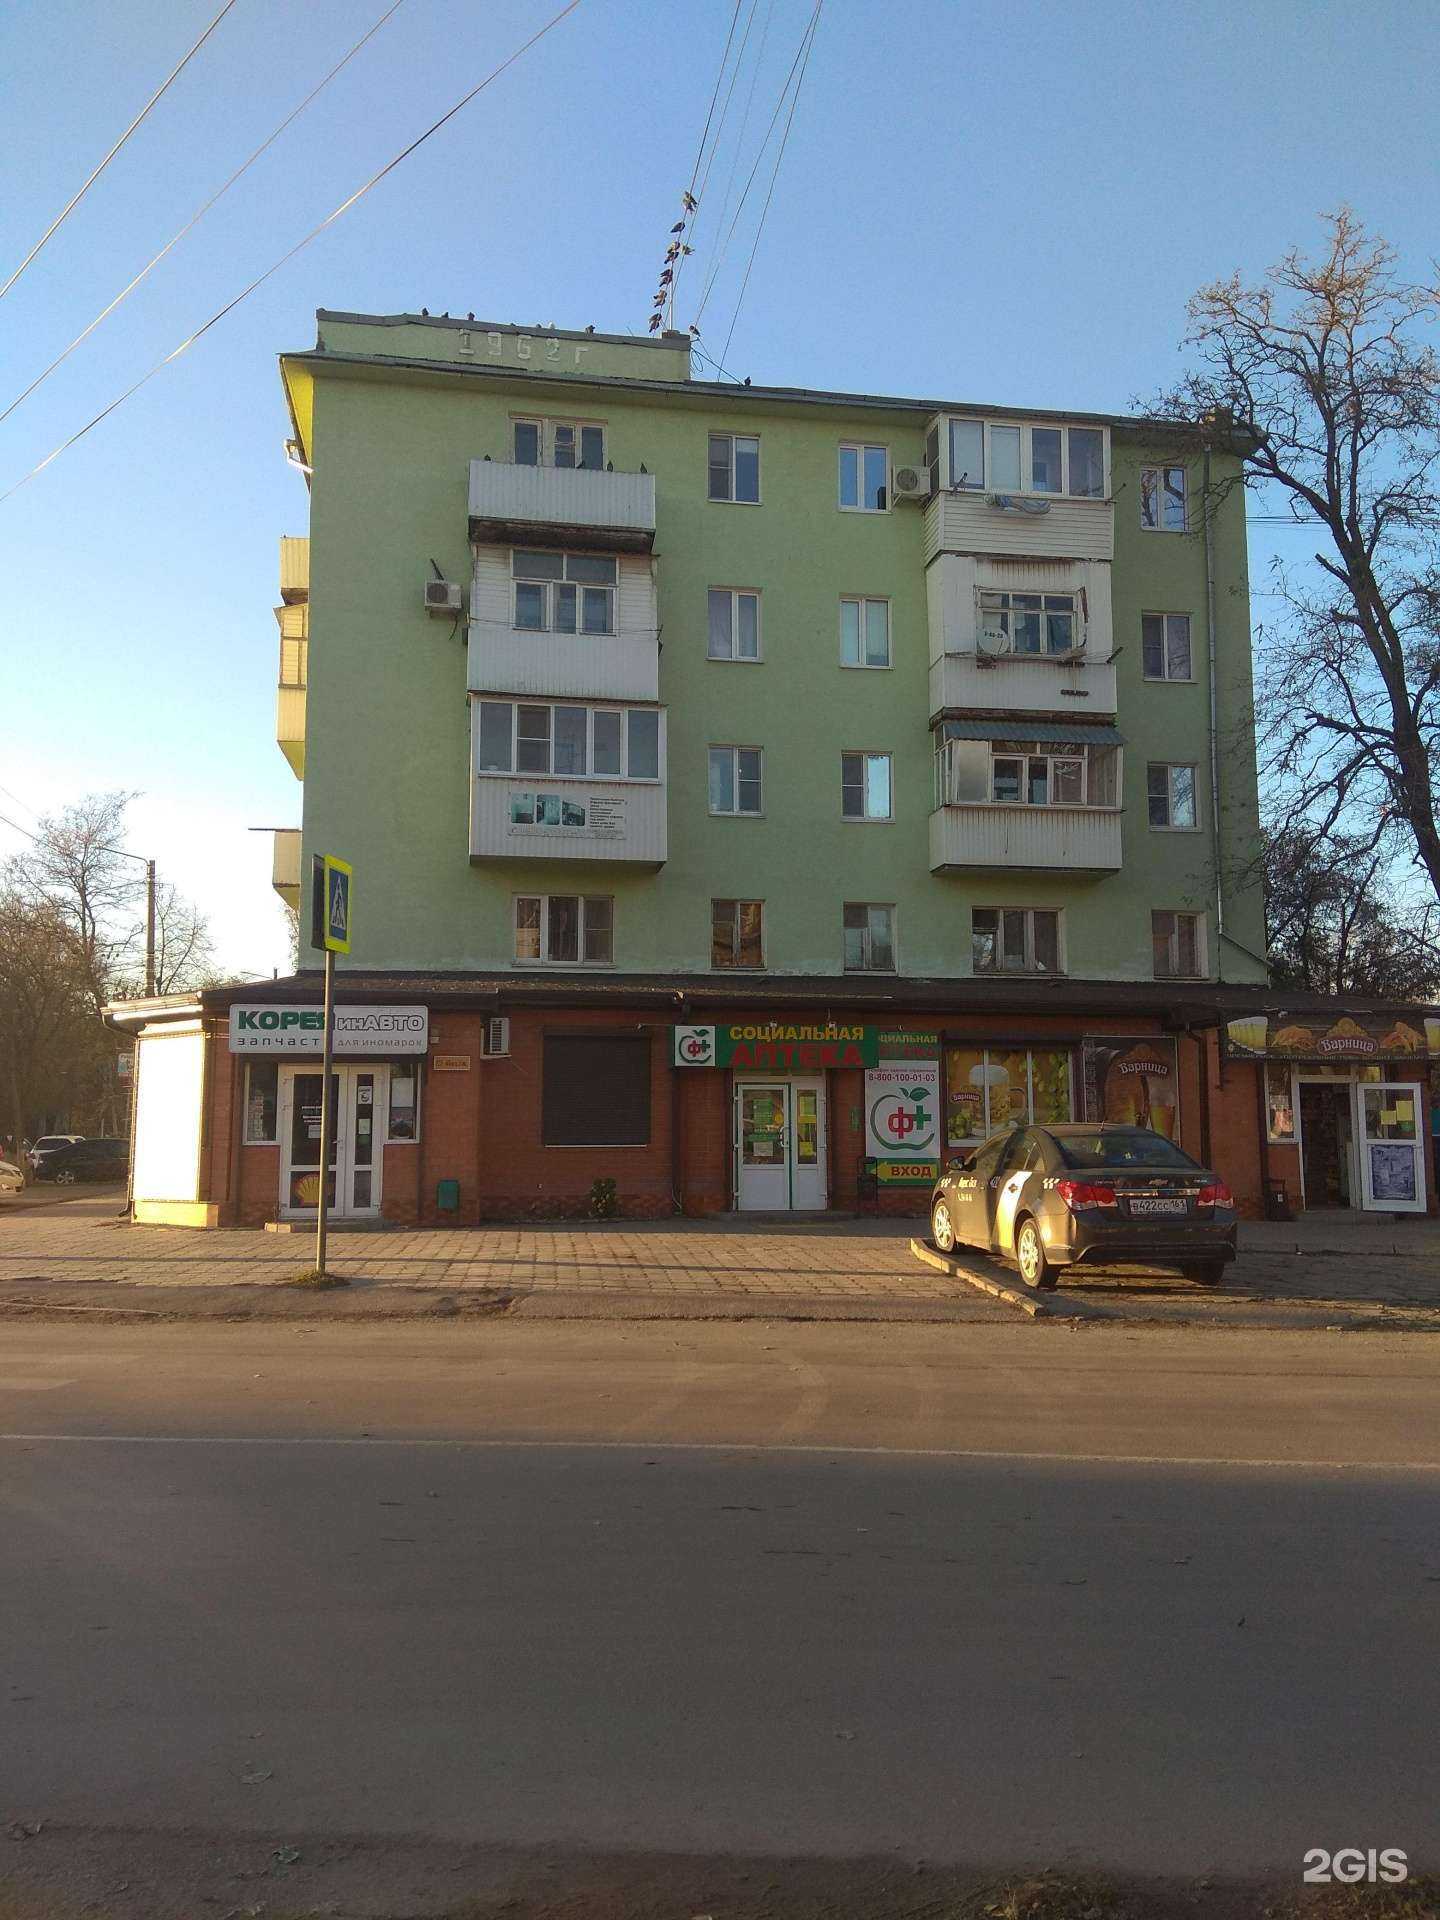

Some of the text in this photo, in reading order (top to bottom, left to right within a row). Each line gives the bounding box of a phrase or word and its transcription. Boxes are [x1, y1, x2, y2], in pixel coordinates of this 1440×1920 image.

[729, 1026, 864, 1041] СОЦИАЛЬНАЯ
[237, 1037, 322, 1047] запчаст
[1320, 1039, 1374, 1053] Варница
[731, 1043, 863, 1066] АПТЕКА
[868, 1073, 936, 1082] 8-800-100-01-03
[891, 1166, 932, 1178] ВХОД
